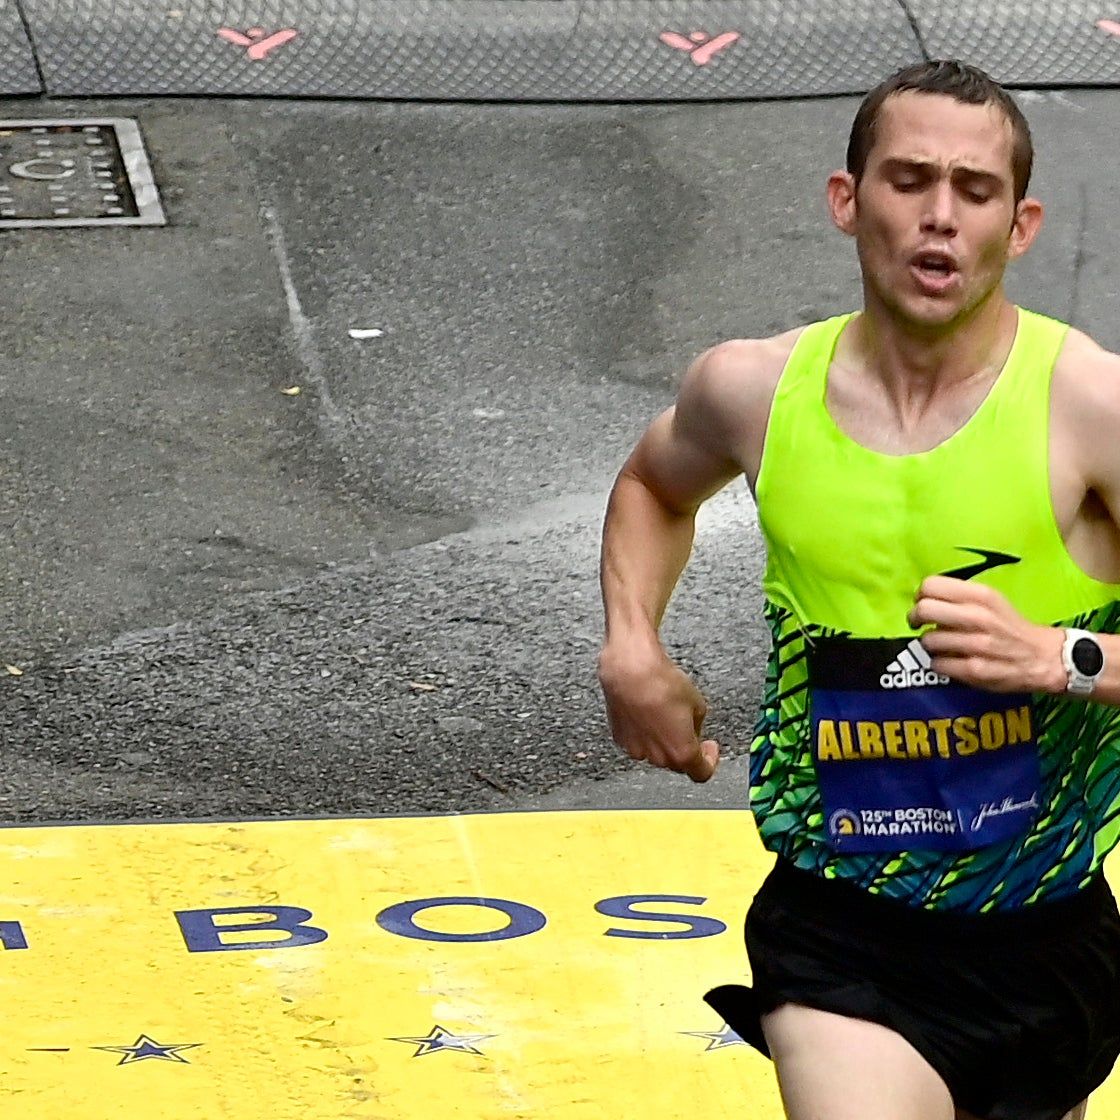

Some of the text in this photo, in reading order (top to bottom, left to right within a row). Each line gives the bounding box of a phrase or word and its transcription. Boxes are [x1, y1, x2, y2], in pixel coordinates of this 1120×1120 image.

[817, 706, 1032, 761] ALBERTSON
[894, 807, 953, 822] BOSTON
[863, 820, 957, 836] MARATHON
